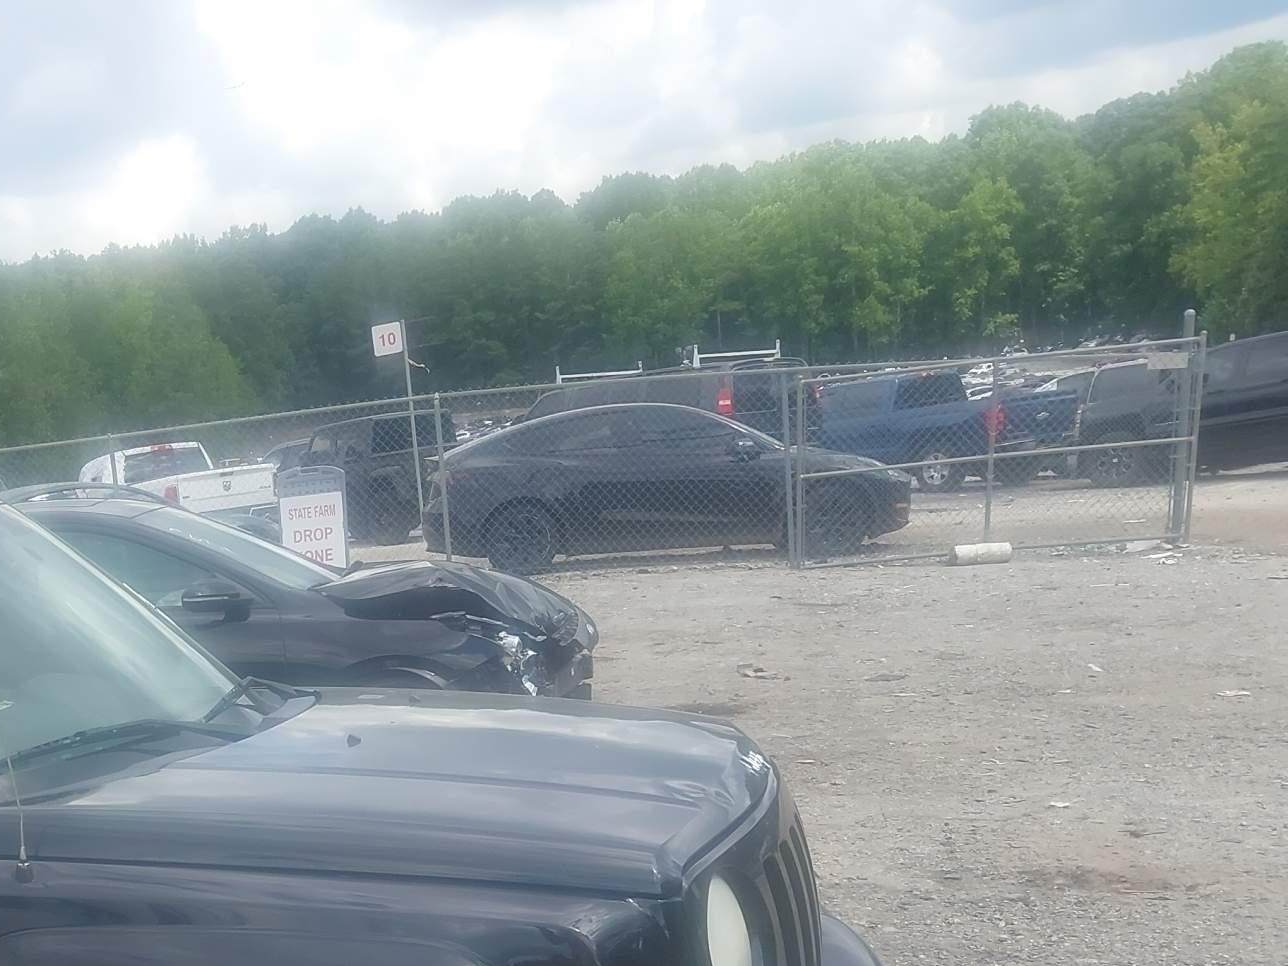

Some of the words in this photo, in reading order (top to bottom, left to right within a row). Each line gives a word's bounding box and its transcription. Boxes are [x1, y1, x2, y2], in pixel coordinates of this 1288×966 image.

[378, 332, 396, 347] 10
[288, 506, 313, 521] STATE
[314, 503, 336, 518] FARM
[293, 527, 333, 543] DROP
[300, 548, 334, 562] ONE
